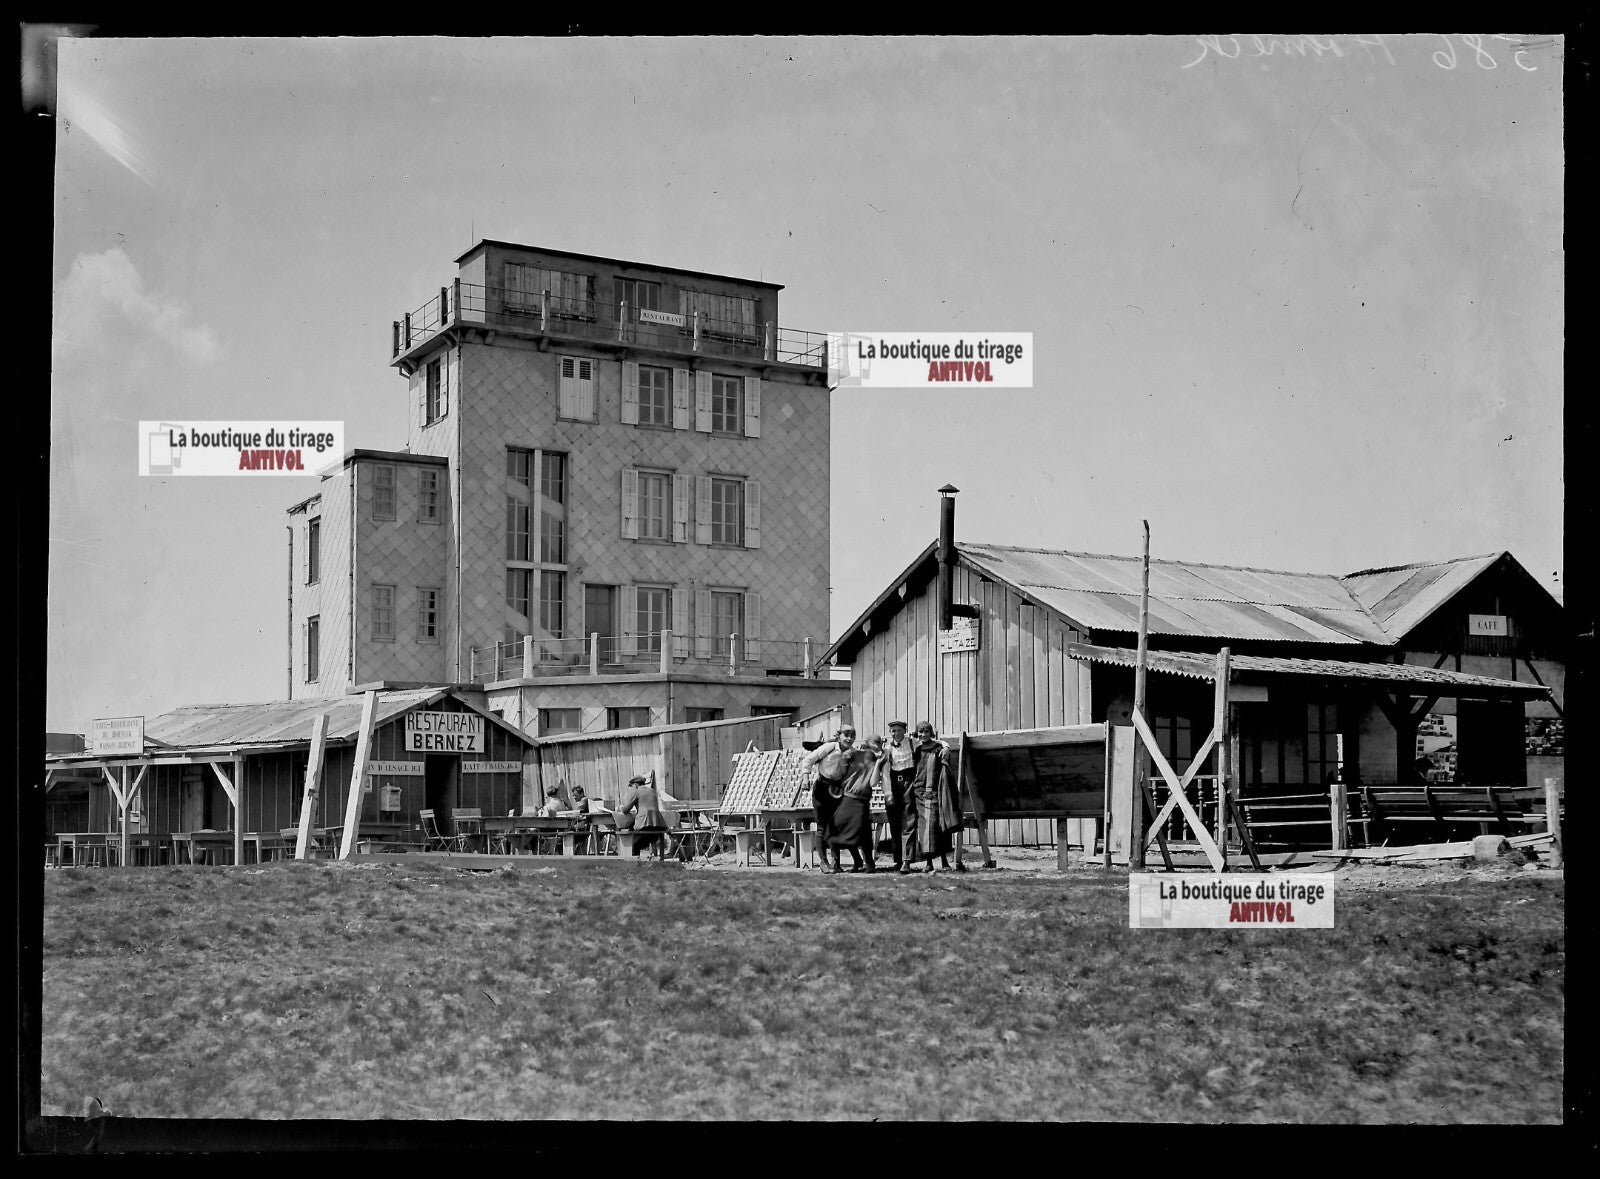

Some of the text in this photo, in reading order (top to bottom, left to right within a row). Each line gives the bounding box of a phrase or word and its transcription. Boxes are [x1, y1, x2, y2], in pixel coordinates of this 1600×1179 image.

[642, 312, 682, 324] RESTAURANT
[407, 712, 483, 733] RESTAURANT
[413, 733, 476, 751] BERNEZ
[464, 763, 481, 771] LAIT
